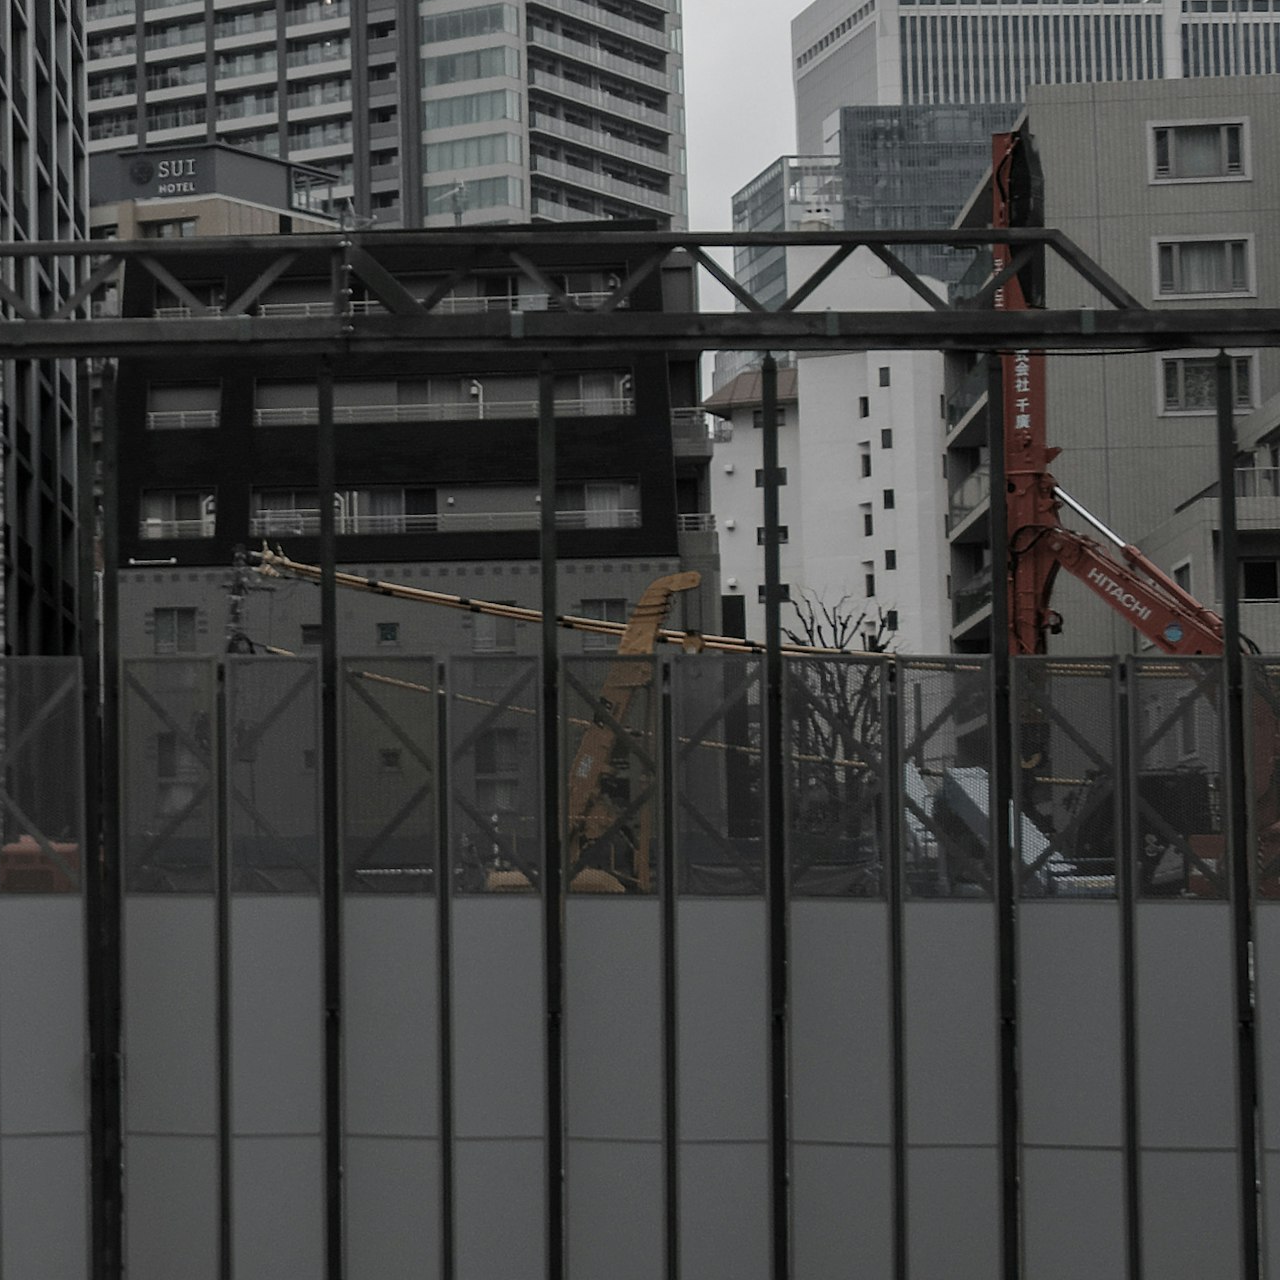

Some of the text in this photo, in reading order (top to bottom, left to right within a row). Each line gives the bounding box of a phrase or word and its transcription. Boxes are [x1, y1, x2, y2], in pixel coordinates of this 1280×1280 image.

[158, 158, 196, 178] SUI
[159, 182, 196, 193] HOTEL
[1088, 568, 1152, 621] HITACHI
